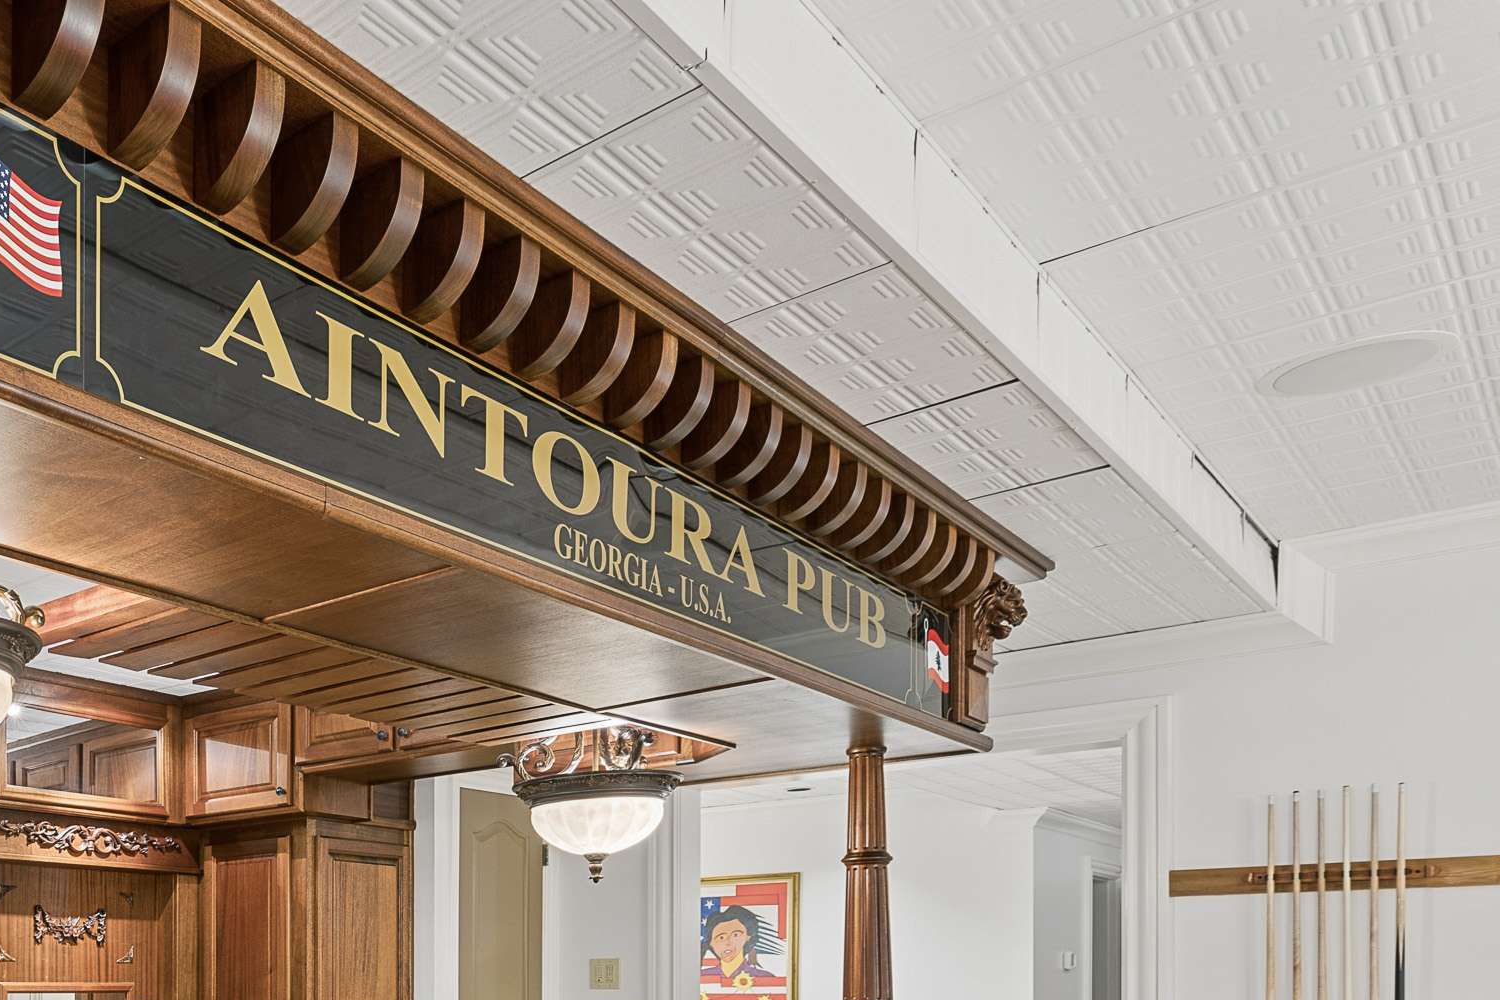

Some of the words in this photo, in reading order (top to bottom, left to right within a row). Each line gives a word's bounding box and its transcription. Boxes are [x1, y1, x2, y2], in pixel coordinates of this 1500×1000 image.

[201, 280, 765, 597] AINTOURA
[783, 548, 887, 649] PUB
[553, 523, 664, 597] GEORGIA
[679, 574, 732, 624] U.S.A.
